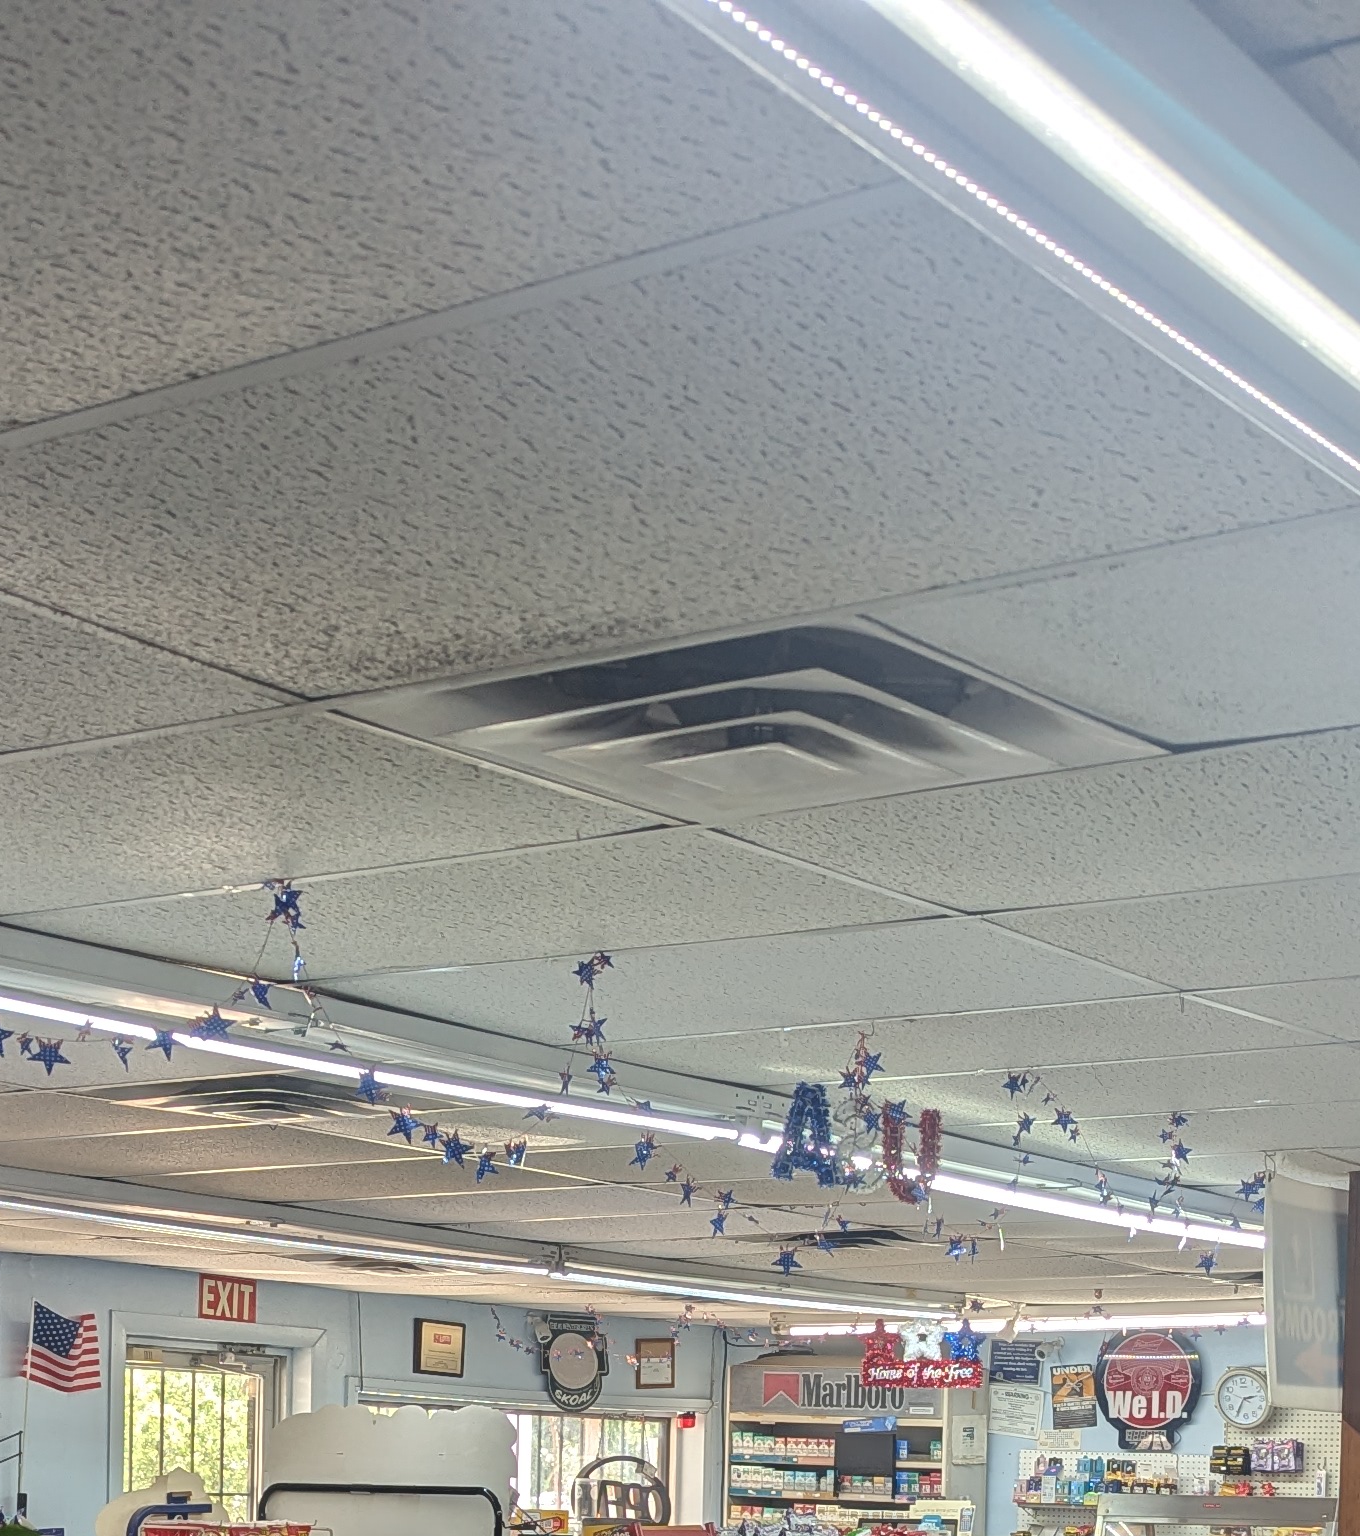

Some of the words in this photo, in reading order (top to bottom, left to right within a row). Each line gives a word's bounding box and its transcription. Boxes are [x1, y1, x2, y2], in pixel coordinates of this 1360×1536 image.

[202, 1279, 254, 1320] EXIT
[867, 1366, 902, 1382] Home
[907, 1365, 919, 1383] of
[922, 1366, 943, 1379] the
[944, 1365, 974, 1383] Free
[1052, 1365, 1091, 1375] UNDER
[554, 1388, 593, 1406] SKOAL
[800, 1372, 906, 1411] Marlboro
[1108, 1391, 1147, 1419] We
[1151, 1390, 1188, 1419] I.D.
